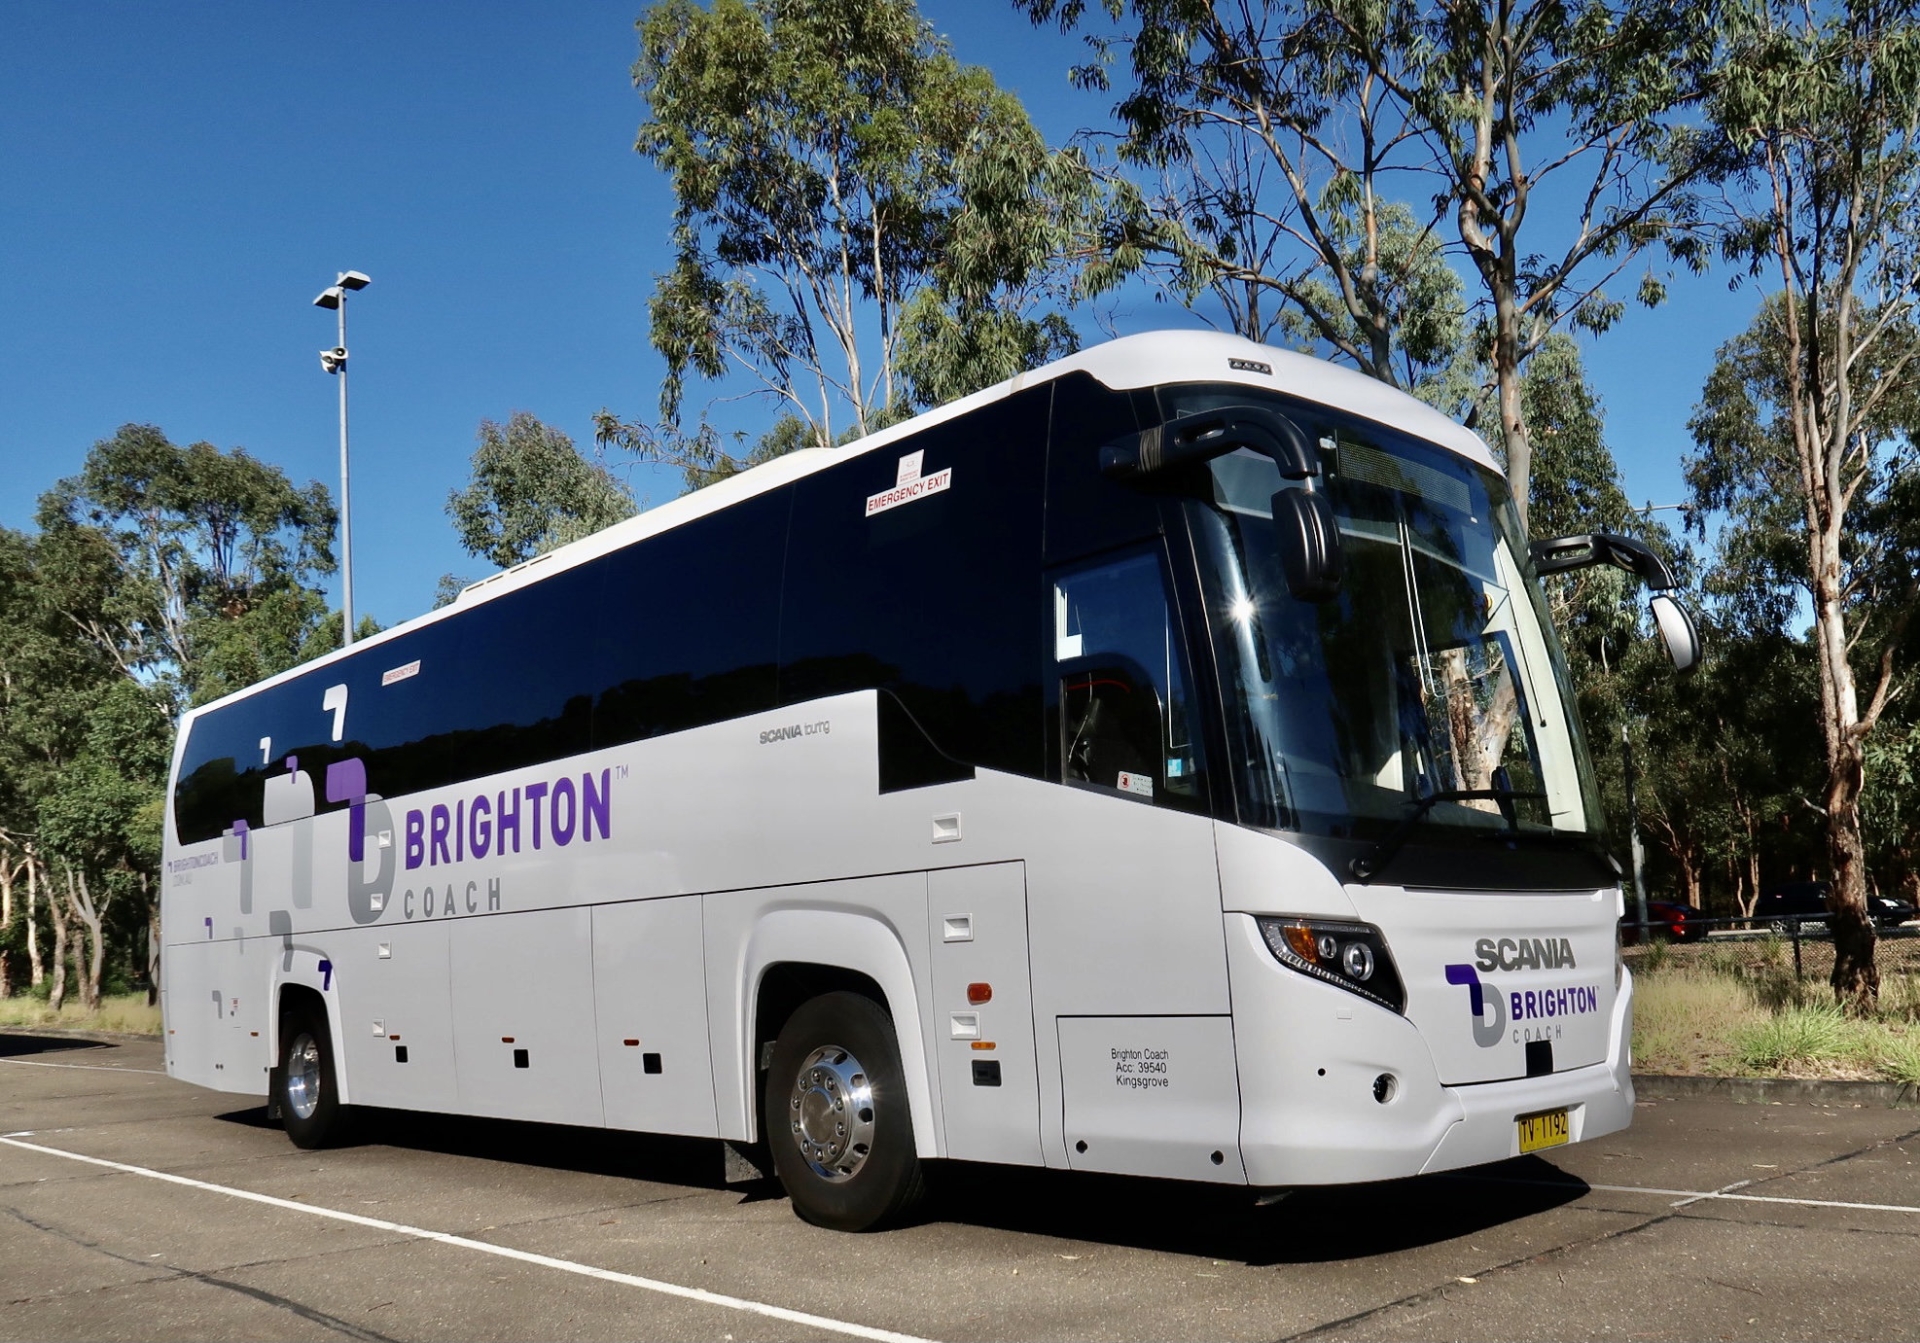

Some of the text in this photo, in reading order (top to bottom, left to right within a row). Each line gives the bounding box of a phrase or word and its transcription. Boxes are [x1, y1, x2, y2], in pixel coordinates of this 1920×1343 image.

[868, 481, 925, 511] EMERGENCY
[928, 473, 949, 490] EXIT
[759, 724, 802, 744] SCANIA
[405, 768, 611, 870] BRIGHTON
[404, 877, 500, 920] COACH
[1475, 938, 1577, 972] SCANIA
[1510, 986, 1597, 1020] BRIGHTON
[1512, 1025, 1562, 1044] COACH
[1111, 1048, 1169, 1062] Brighton Coach
[1116, 1062, 1167, 1074] Acc: 39540
[1116, 1075, 1169, 1089] Kingsgrove
